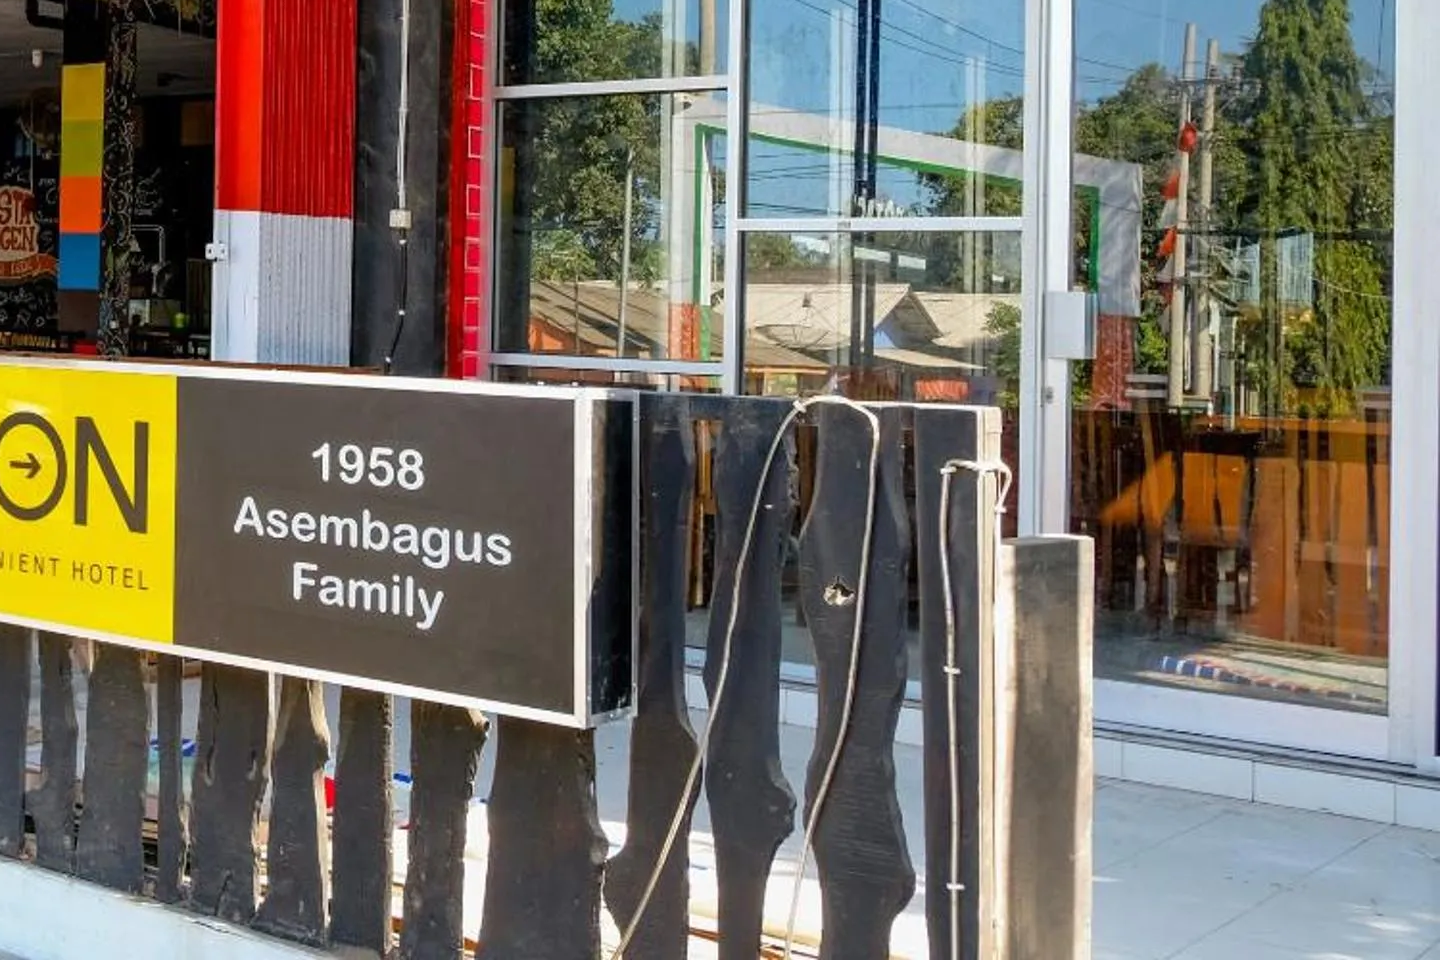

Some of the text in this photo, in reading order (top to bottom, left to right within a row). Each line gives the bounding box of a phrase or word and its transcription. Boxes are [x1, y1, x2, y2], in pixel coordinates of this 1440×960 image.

[311, 442, 426, 491] 1958
[233, 496, 513, 570] Asembagus
[71, 559, 150, 591] HOTEL
[292, 561, 445, 631] Family
